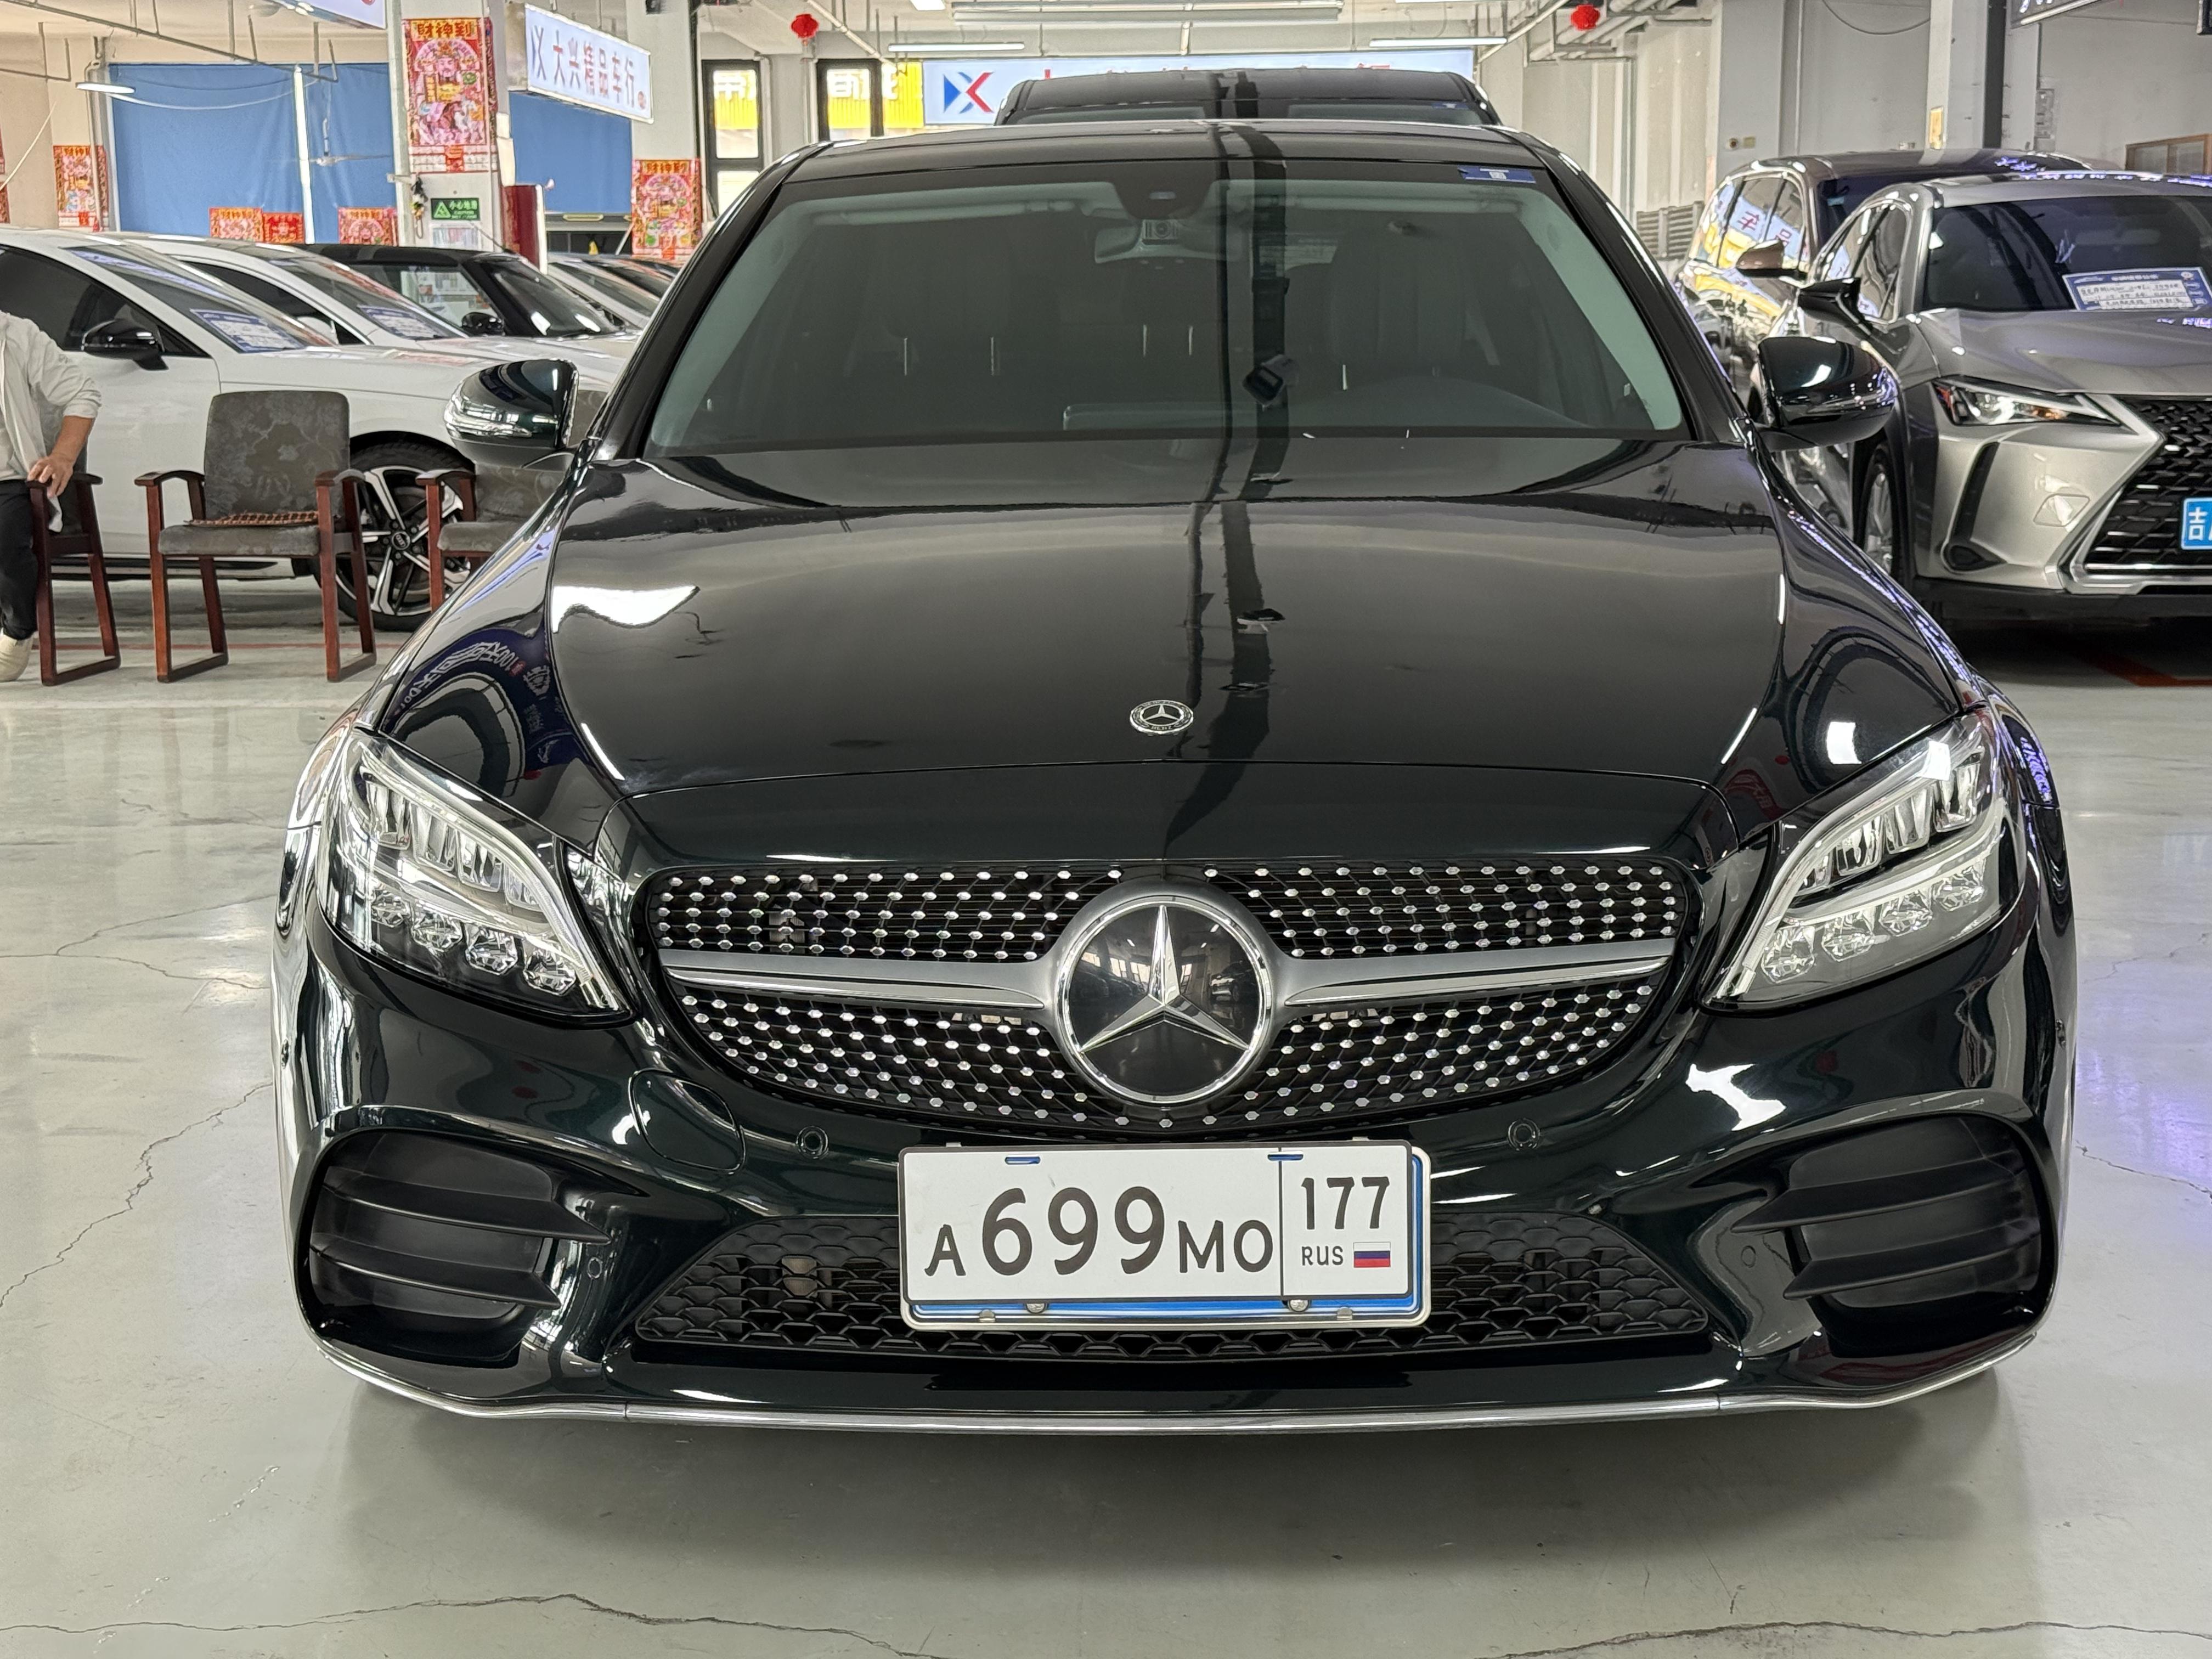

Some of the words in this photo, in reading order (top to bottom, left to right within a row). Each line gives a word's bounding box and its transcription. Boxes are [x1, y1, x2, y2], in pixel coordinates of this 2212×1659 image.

[552, 29, 634, 108] 大兴精品车行
[2188, 506, 2212, 541] 吉
[1302, 1177, 1389, 1229] 177
[1302, 1246, 1343, 1265] RUS
